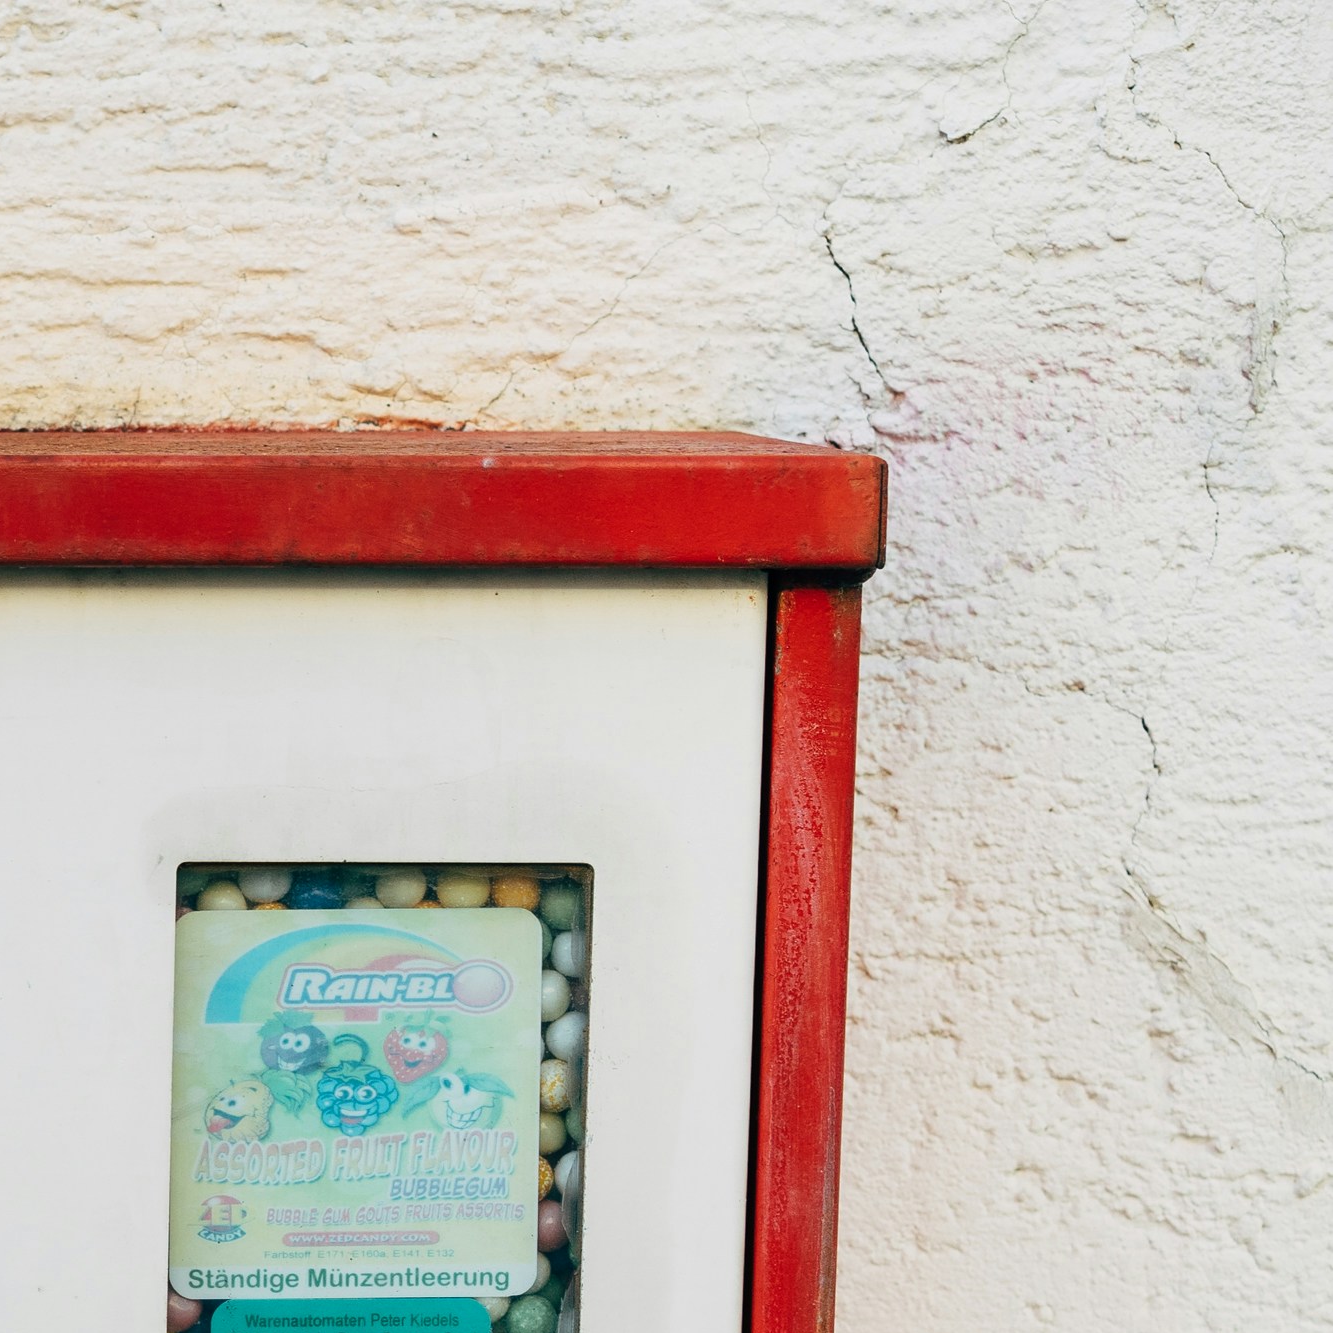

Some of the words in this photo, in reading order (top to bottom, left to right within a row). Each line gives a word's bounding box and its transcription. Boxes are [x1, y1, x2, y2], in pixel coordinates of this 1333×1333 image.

[194, 1139, 324, 1184] ASSORTED
[335, 1134, 405, 1179] FRUIT
[408, 1130, 517, 1174] FLAVOUR
[390, 1177, 509, 1200] BUBBLEGUM
[266, 1207, 318, 1226] BUBBLE
[322, 1207, 351, 1225] GUM
[405, 1202, 452, 1222] FRUITS
[455, 1202, 525, 1222] ASSORTIS
[199, 1226, 246, 1242] CANDY
[264, 1250, 311, 1260] Farbstoff
[188, 1268, 300, 1293] Ständige
[308, 1267, 510, 1292] Münzentleerung
[245, 1314, 366, 1328] Warenautomaten
[371, 1313, 406, 1327] Peter
[410, 1313, 460, 1327] Kiedels
